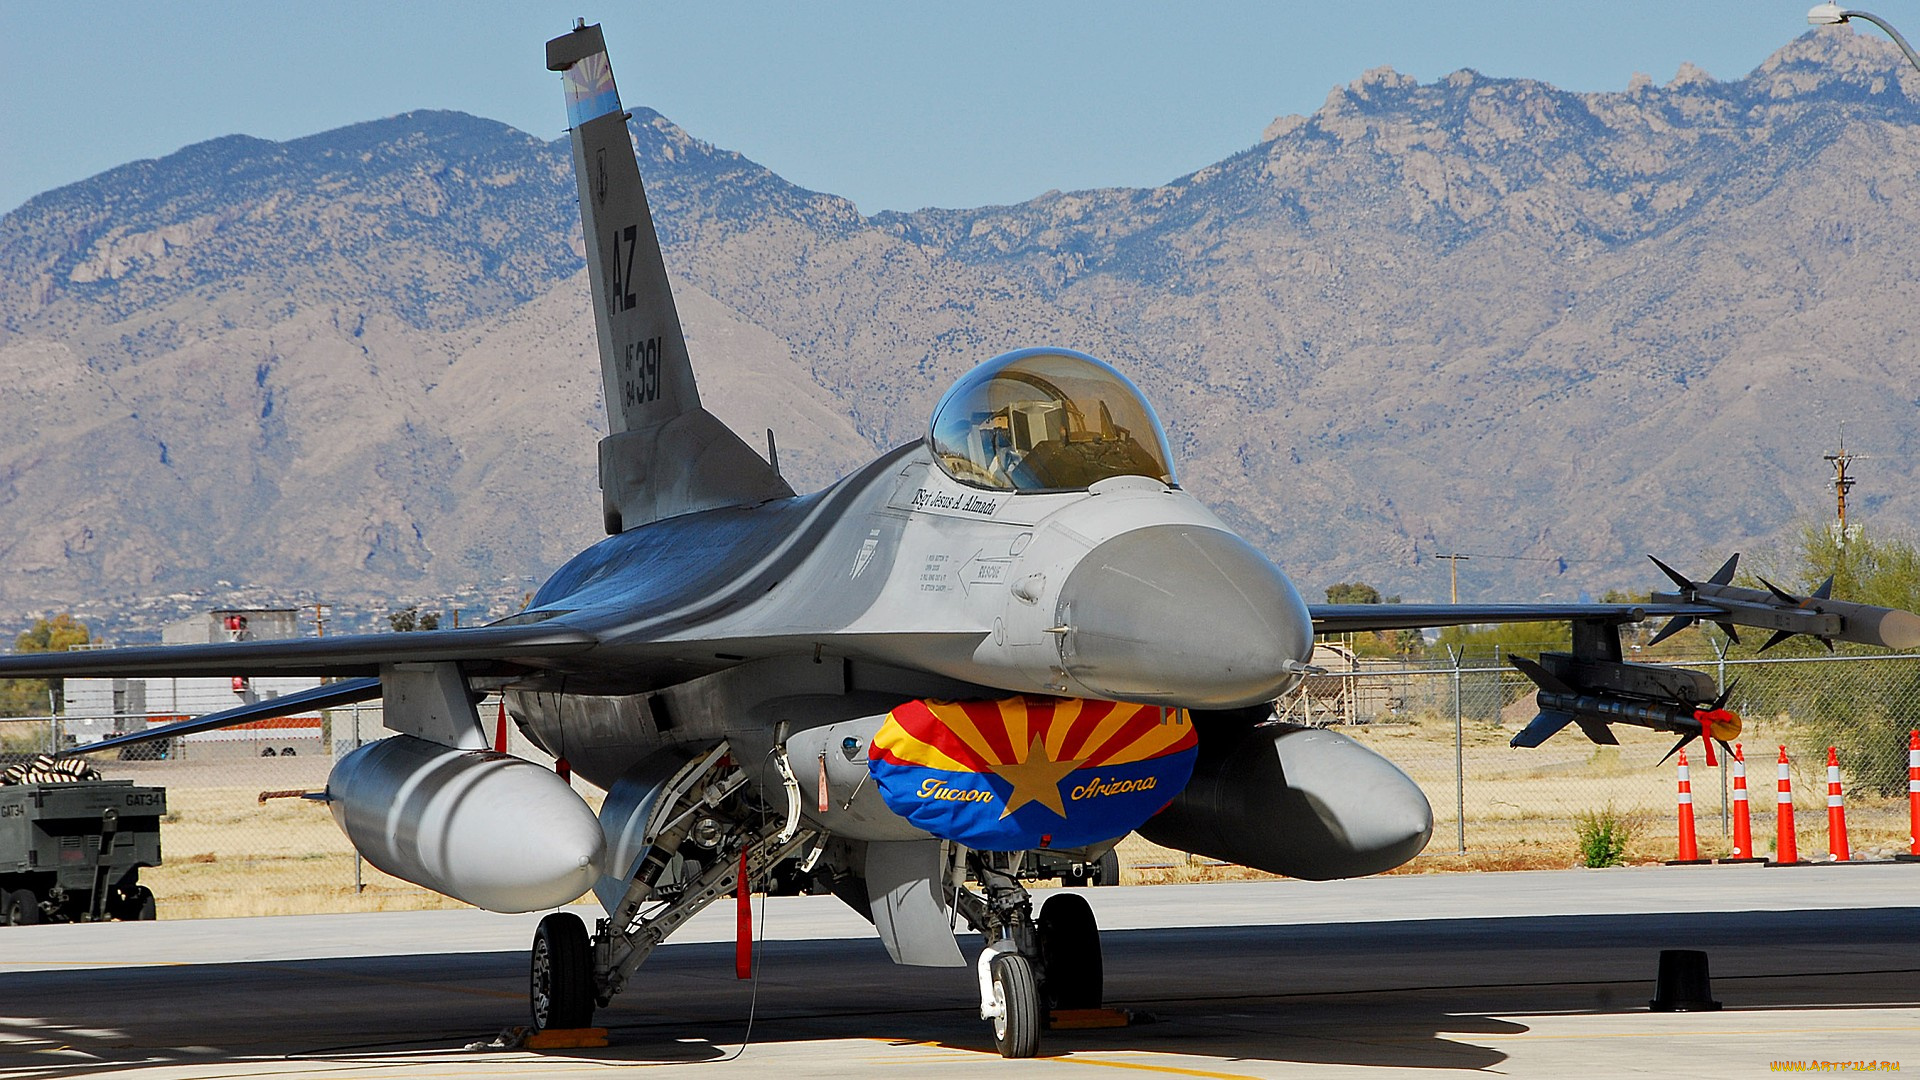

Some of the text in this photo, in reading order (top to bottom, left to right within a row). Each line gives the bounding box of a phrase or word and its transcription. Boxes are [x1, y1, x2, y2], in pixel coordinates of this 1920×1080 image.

[612, 225, 637, 316] AZ
[625, 343, 634, 373] AF
[636, 336, 662, 404] 391
[911, 488, 996, 516] TSgt Jesus A Almada
[126, 793, 160, 807] GAT34
[916, 776, 1158, 804] Tucson Arizona
[1, 804, 24, 818] GAT34
